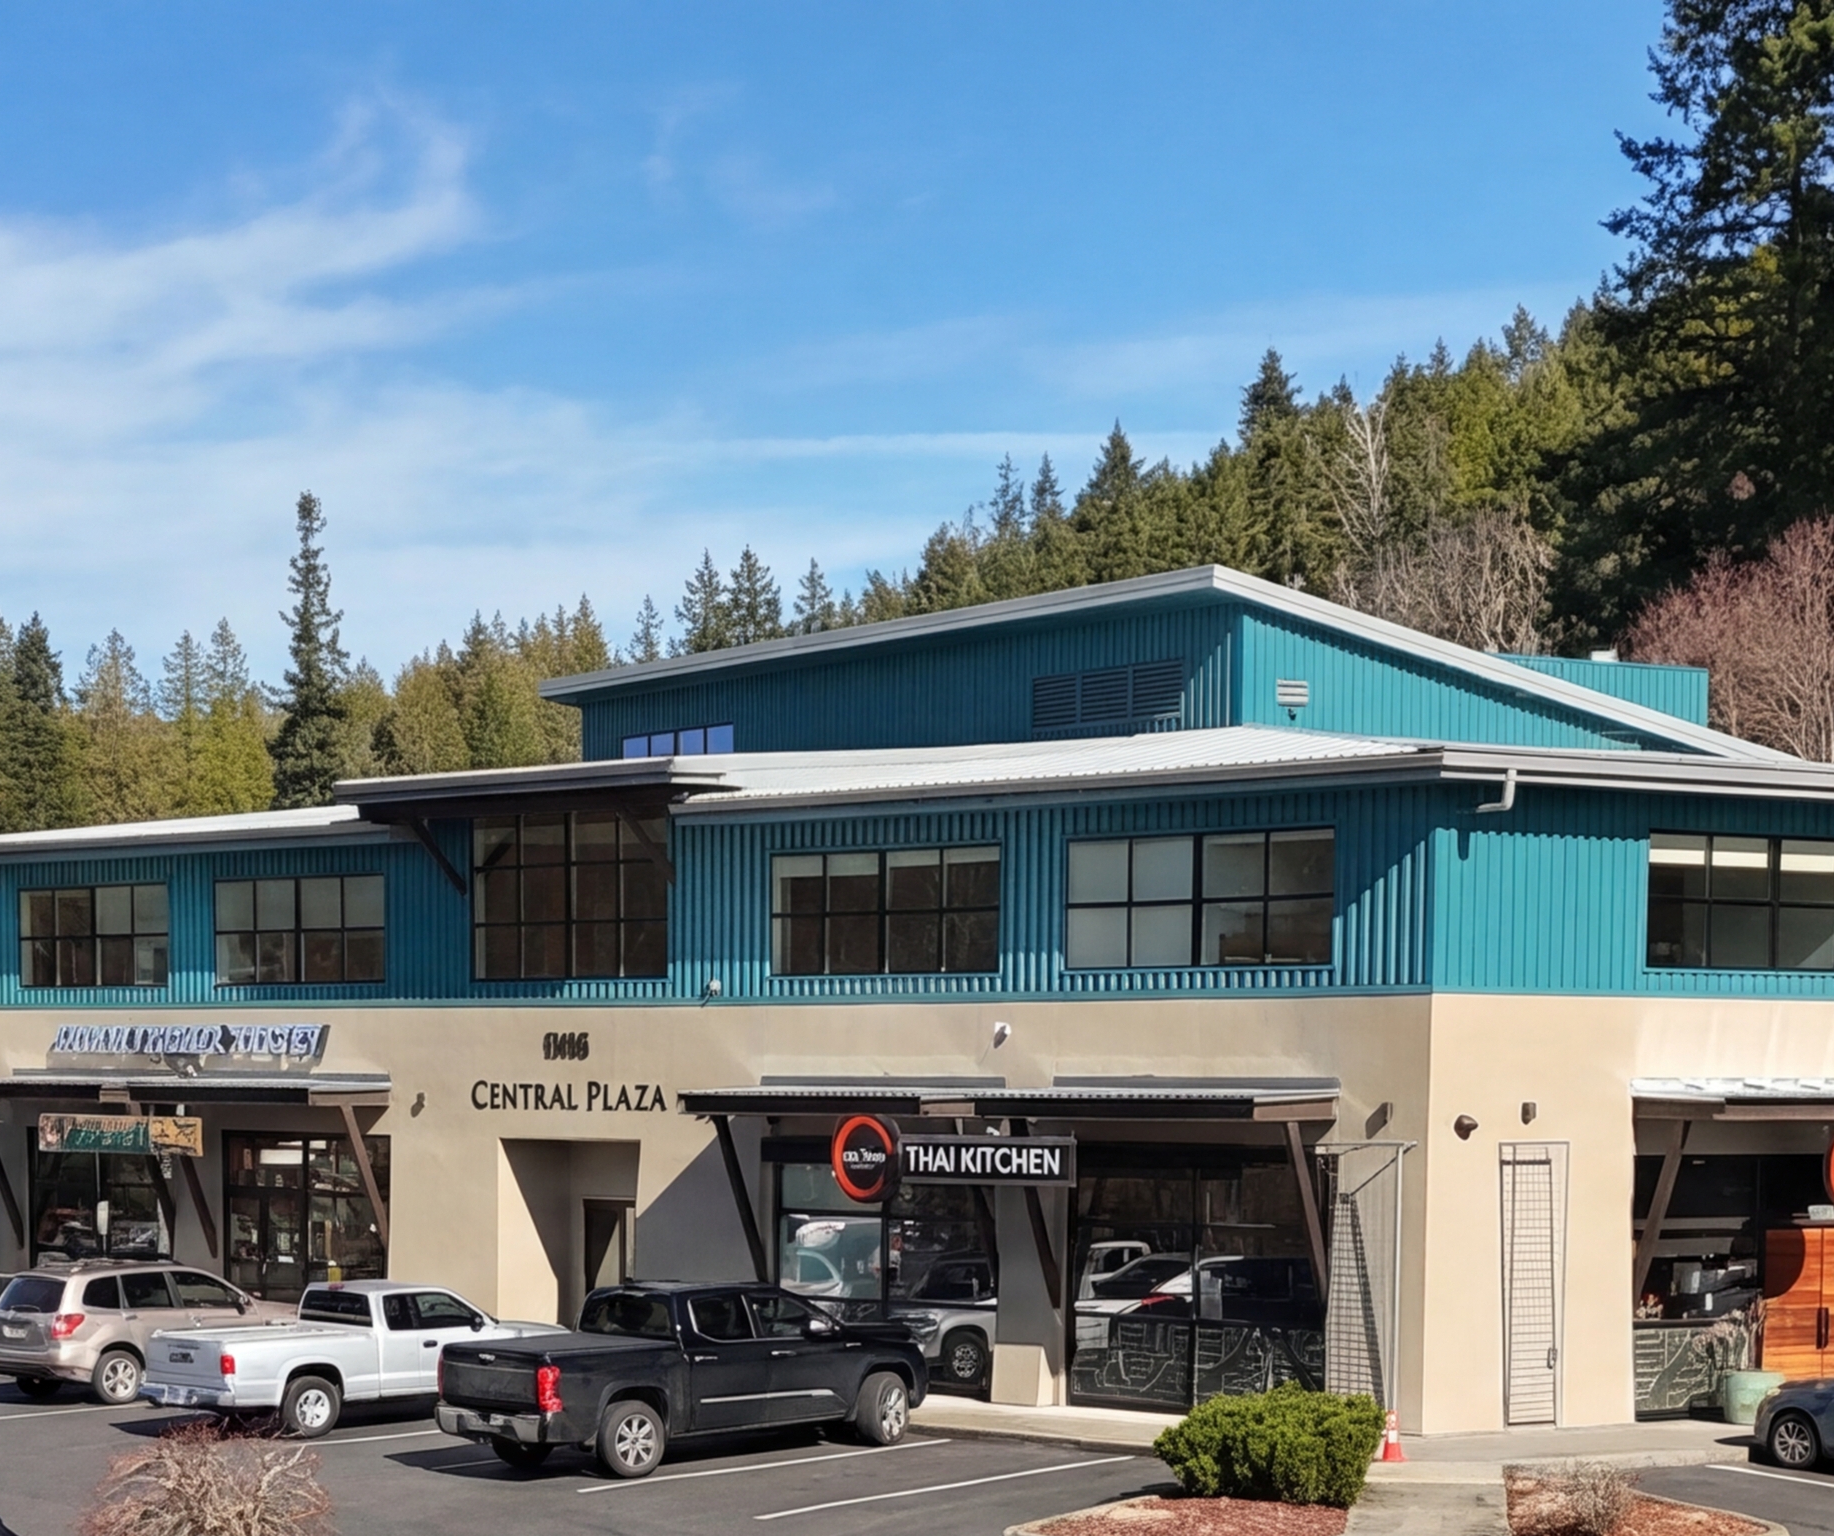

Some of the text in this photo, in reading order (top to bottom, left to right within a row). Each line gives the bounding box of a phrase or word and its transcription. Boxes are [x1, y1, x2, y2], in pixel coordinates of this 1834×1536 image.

[471, 1080, 667, 1112] CENTRAL PLAZA
[906, 1146, 955, 1172] THAI
[961, 1147, 1060, 1175] KITCHEN
